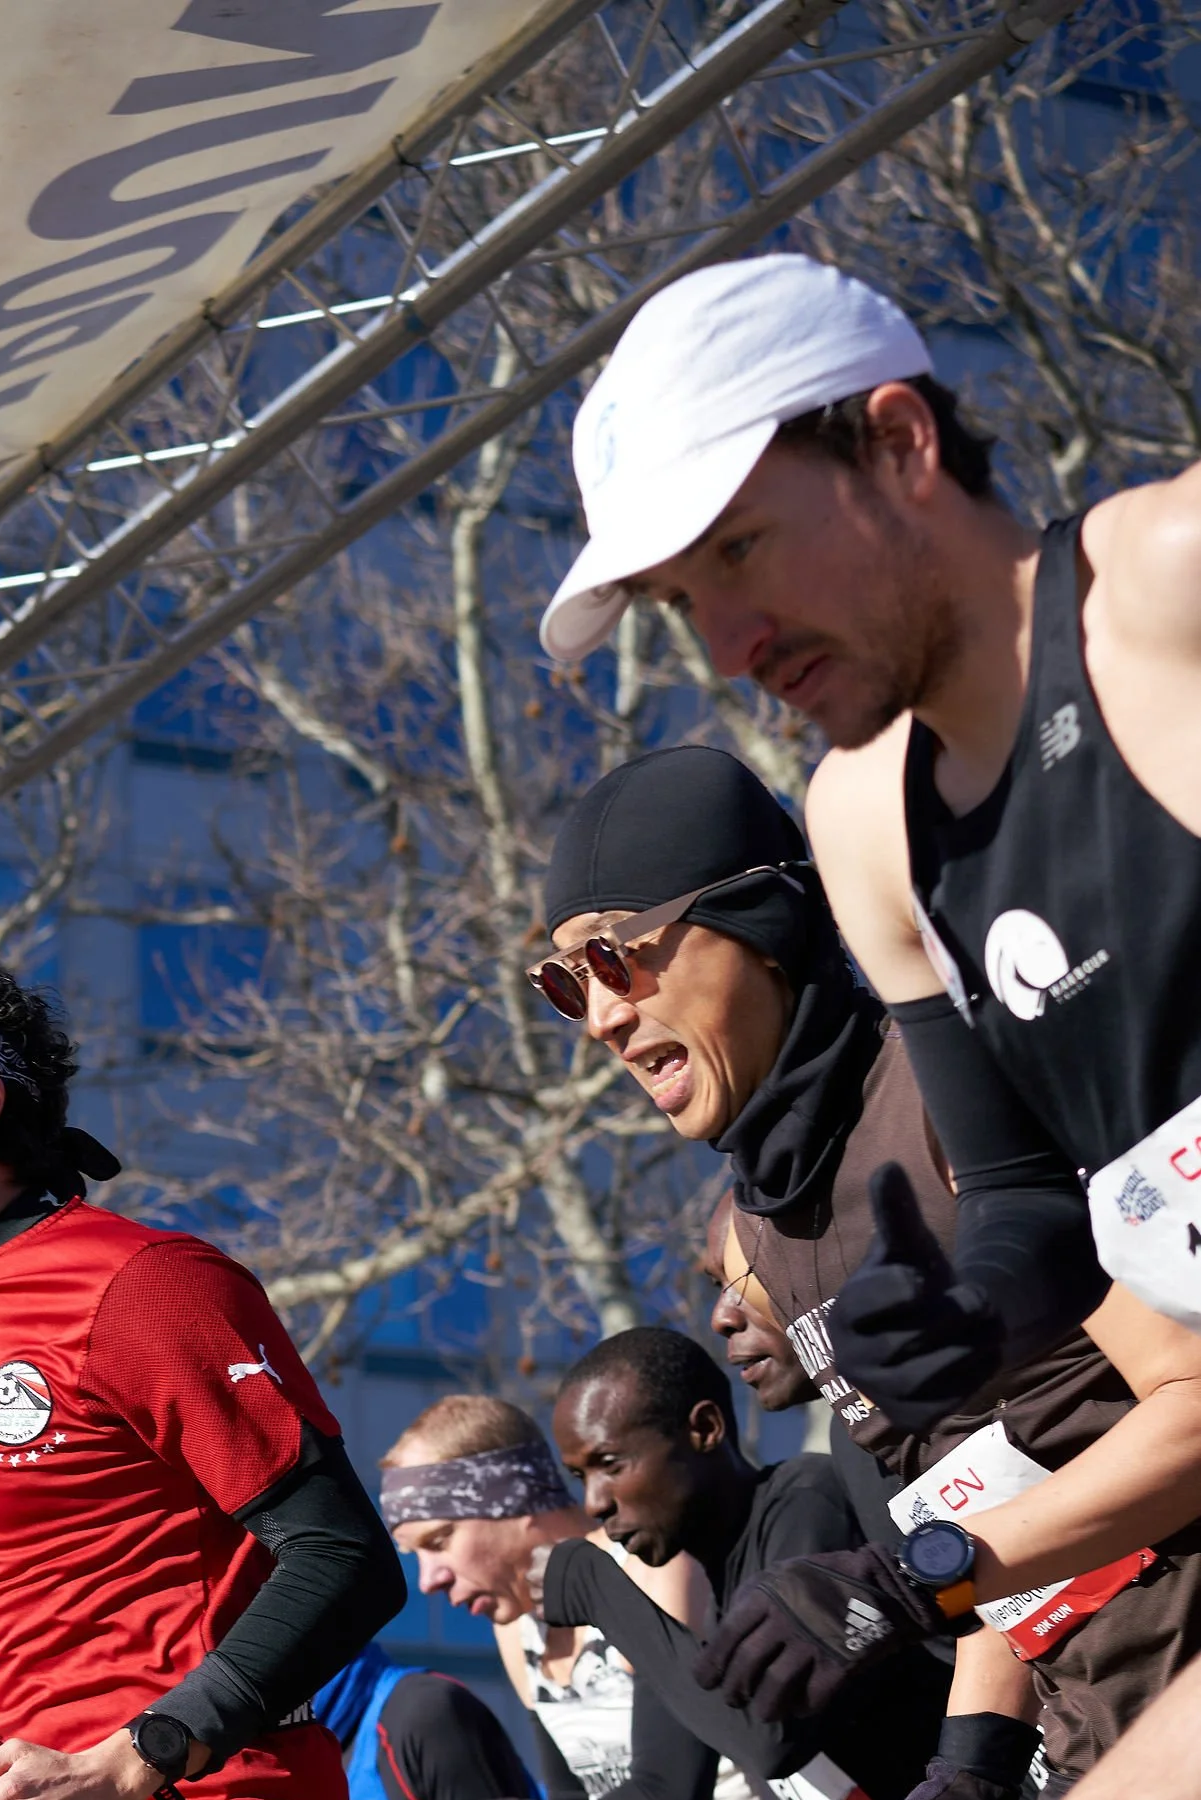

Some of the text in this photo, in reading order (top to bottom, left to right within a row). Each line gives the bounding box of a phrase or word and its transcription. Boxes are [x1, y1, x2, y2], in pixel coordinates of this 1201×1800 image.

[1049, 948, 1110, 998] HARBOUR
[841, 1400, 870, 1426] 905
[939, 1467, 984, 1511] CN
[1032, 1603, 1075, 1637] 30K RUN
